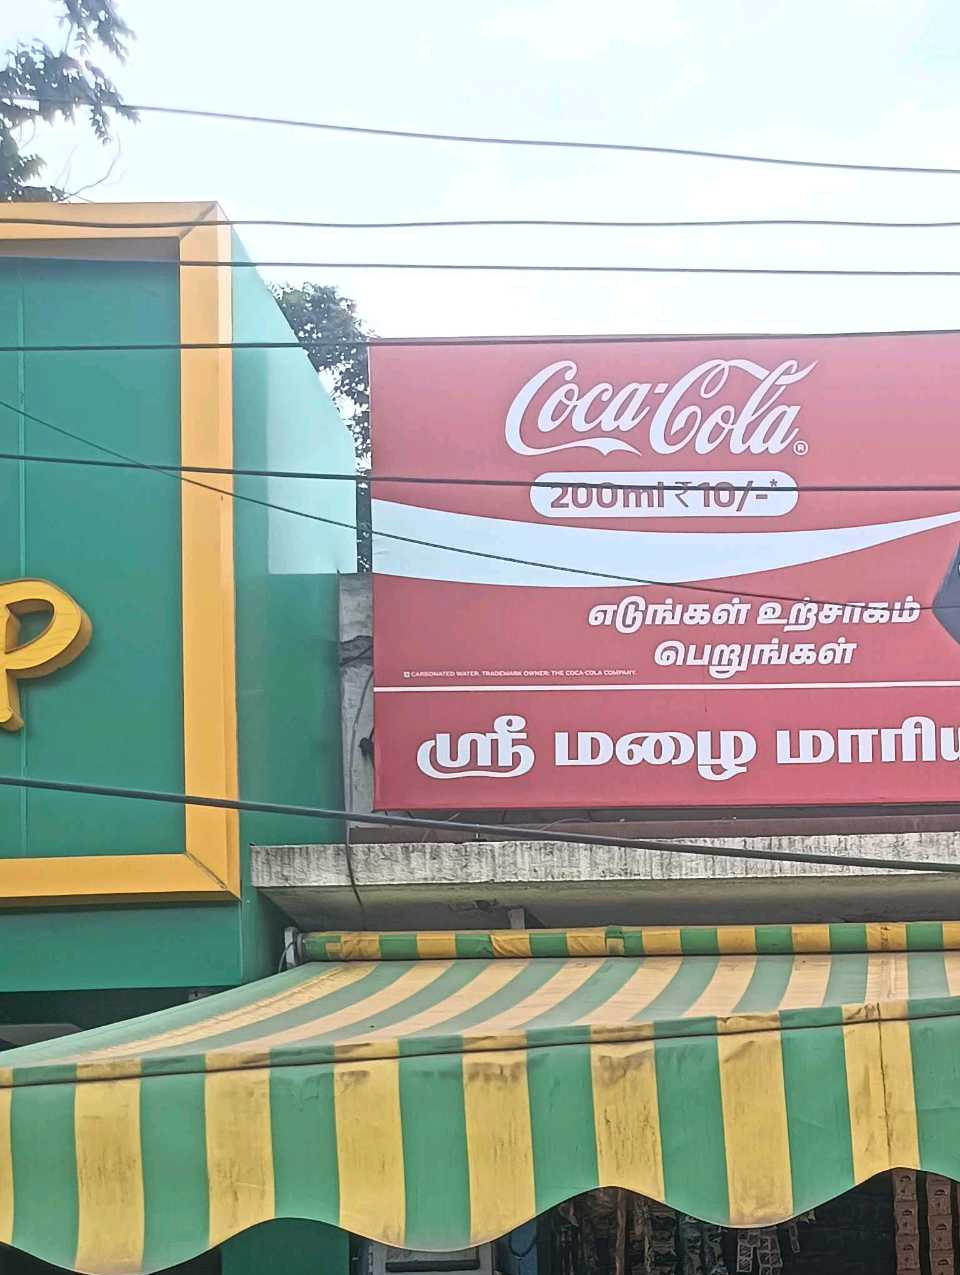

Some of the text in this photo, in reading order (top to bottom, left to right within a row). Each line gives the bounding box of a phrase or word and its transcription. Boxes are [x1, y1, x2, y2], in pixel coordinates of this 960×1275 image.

[505, 360, 817, 456] Coca-Cola
[550, 482, 664, 508] 200ml
[588, 595, 920, 634] எடுங்கள் உற்சாகம்
[654, 638, 857, 679] பெறுங்கள்
[554, 727, 758, 781] மழை
